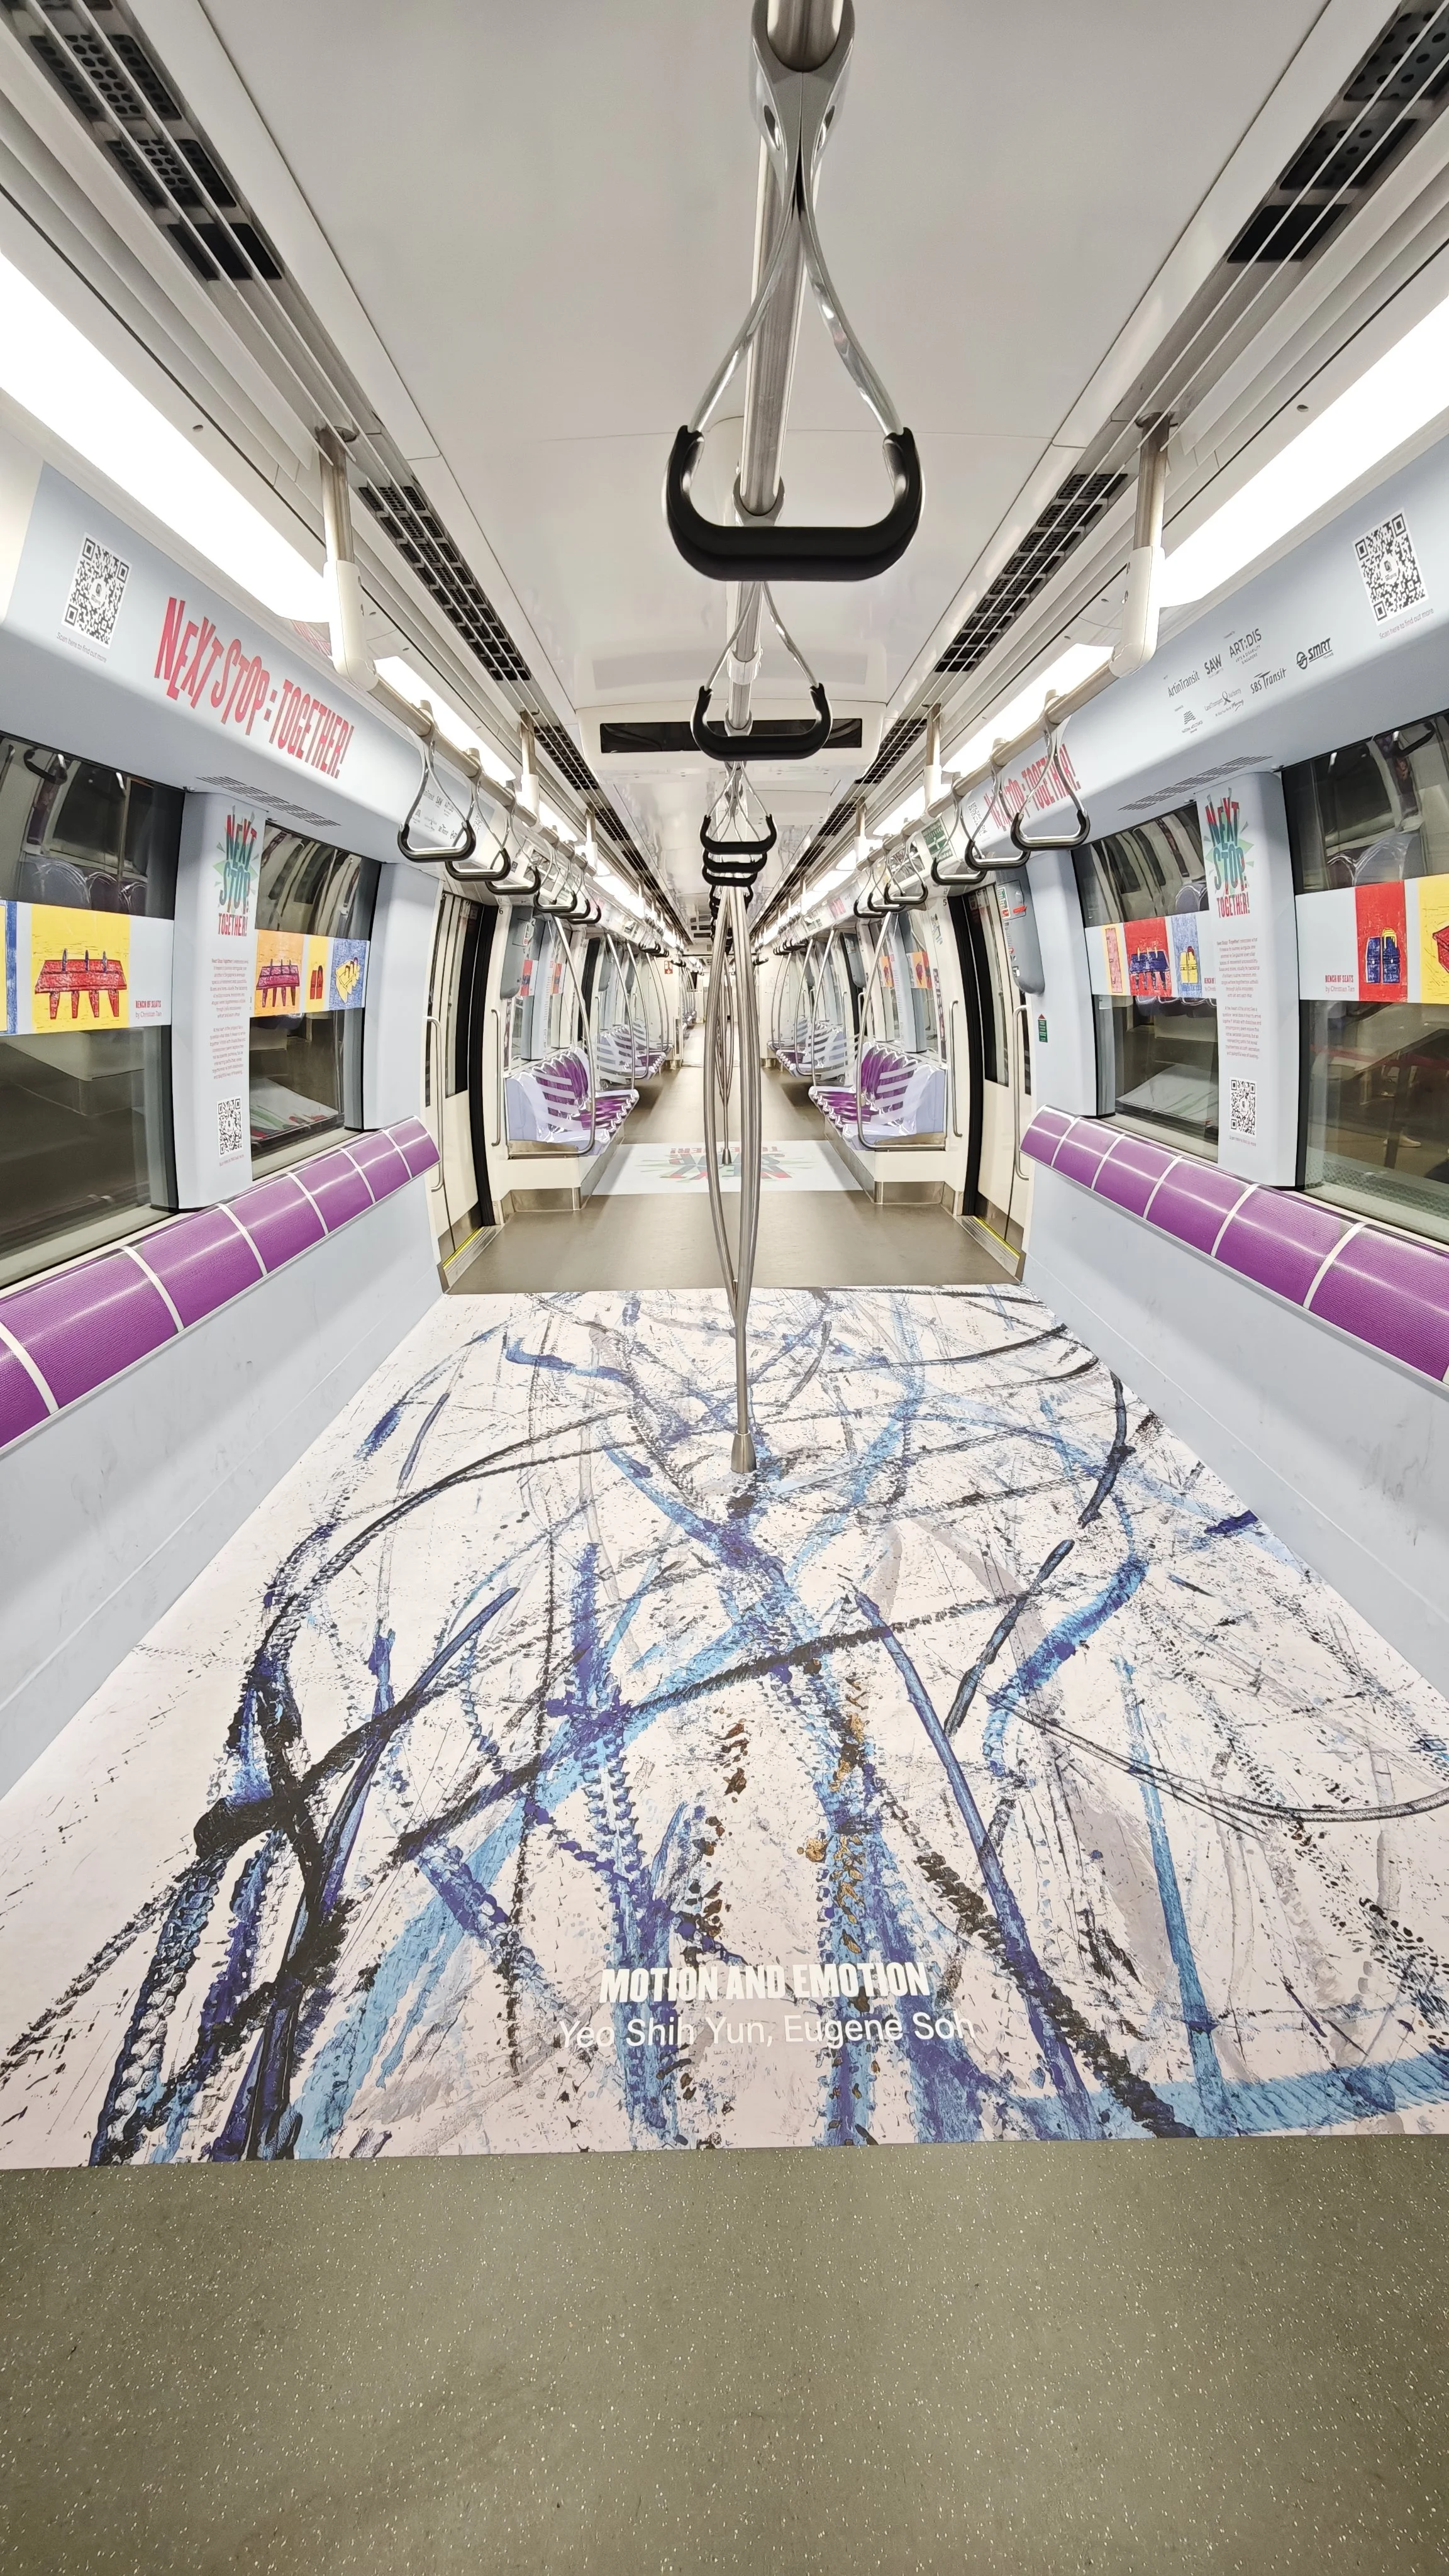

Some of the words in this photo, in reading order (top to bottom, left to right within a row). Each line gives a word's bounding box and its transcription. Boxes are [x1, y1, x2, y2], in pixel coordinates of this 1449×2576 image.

[1379, 630, 1391, 639] Scan
[1390, 626, 1400, 634] here
[1404, 617, 1414, 627] find
[1421, 608, 1434, 618] more
[57, 631, 68, 644] Scan
[67, 637, 77, 649] here
[82, 645, 90, 655] find
[1308, 638, 1331, 660] SMRT
[1204, 654, 1222, 675] SAW
[154, 596, 225, 709] NEXT
[269, 679, 354, 779] TOGETHER!
[1168, 670, 1200, 698] ArtinTransit
[1250, 681, 1262, 694] SBS
[1260, 667, 1287, 689] Transit
[1205, 797, 1239, 850] NEXT
[226, 814, 257, 872] NEXT
[1216, 892, 1250, 918] TOGETHER!
[218, 913, 248, 936] TOGETHER!
[600, 1965, 721, 2003] MOTION
[726, 1963, 786, 2001] AND
[793, 1962, 930, 1997] EMOTION
[560, 2020, 616, 2048] Yeo
[627, 2015, 694, 2048] Shih
[708, 2017, 775, 2048] Yun,
[785, 2014, 904, 2050] Eugene
[913, 2011, 975, 2041] Soh
